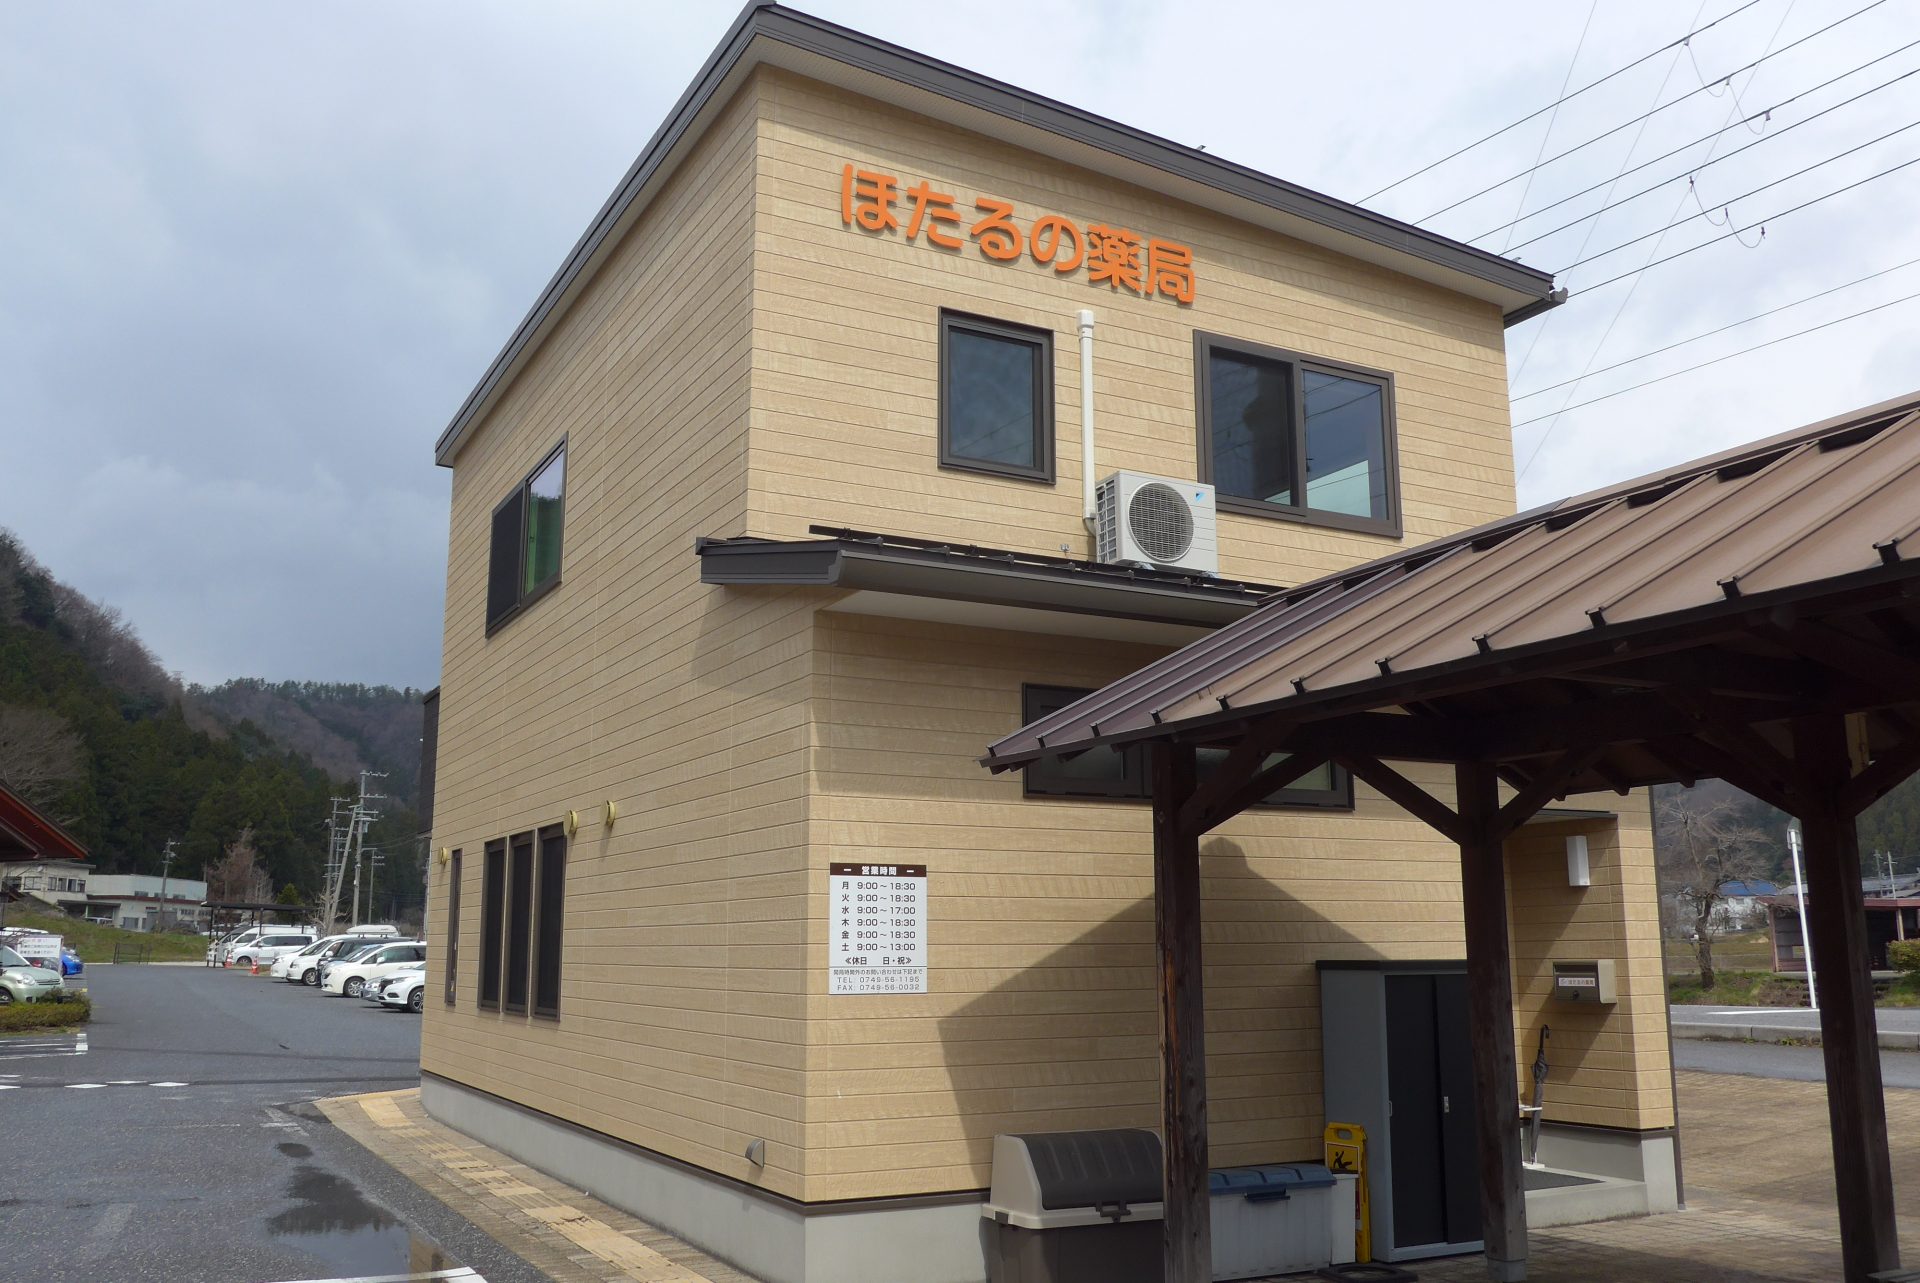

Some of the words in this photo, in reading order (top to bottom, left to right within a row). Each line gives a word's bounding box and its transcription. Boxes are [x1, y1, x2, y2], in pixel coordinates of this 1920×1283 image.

[841, 164, 1195, 304] ほたるの薬局
[862, 866, 897, 876] 営業時間
[841, 882, 849, 890] 月
[841, 894, 849, 902] 火
[841, 906, 849, 914] 水
[841, 918, 849, 926] 木
[841, 930, 849, 939] 金
[841, 943, 849, 951] 土
